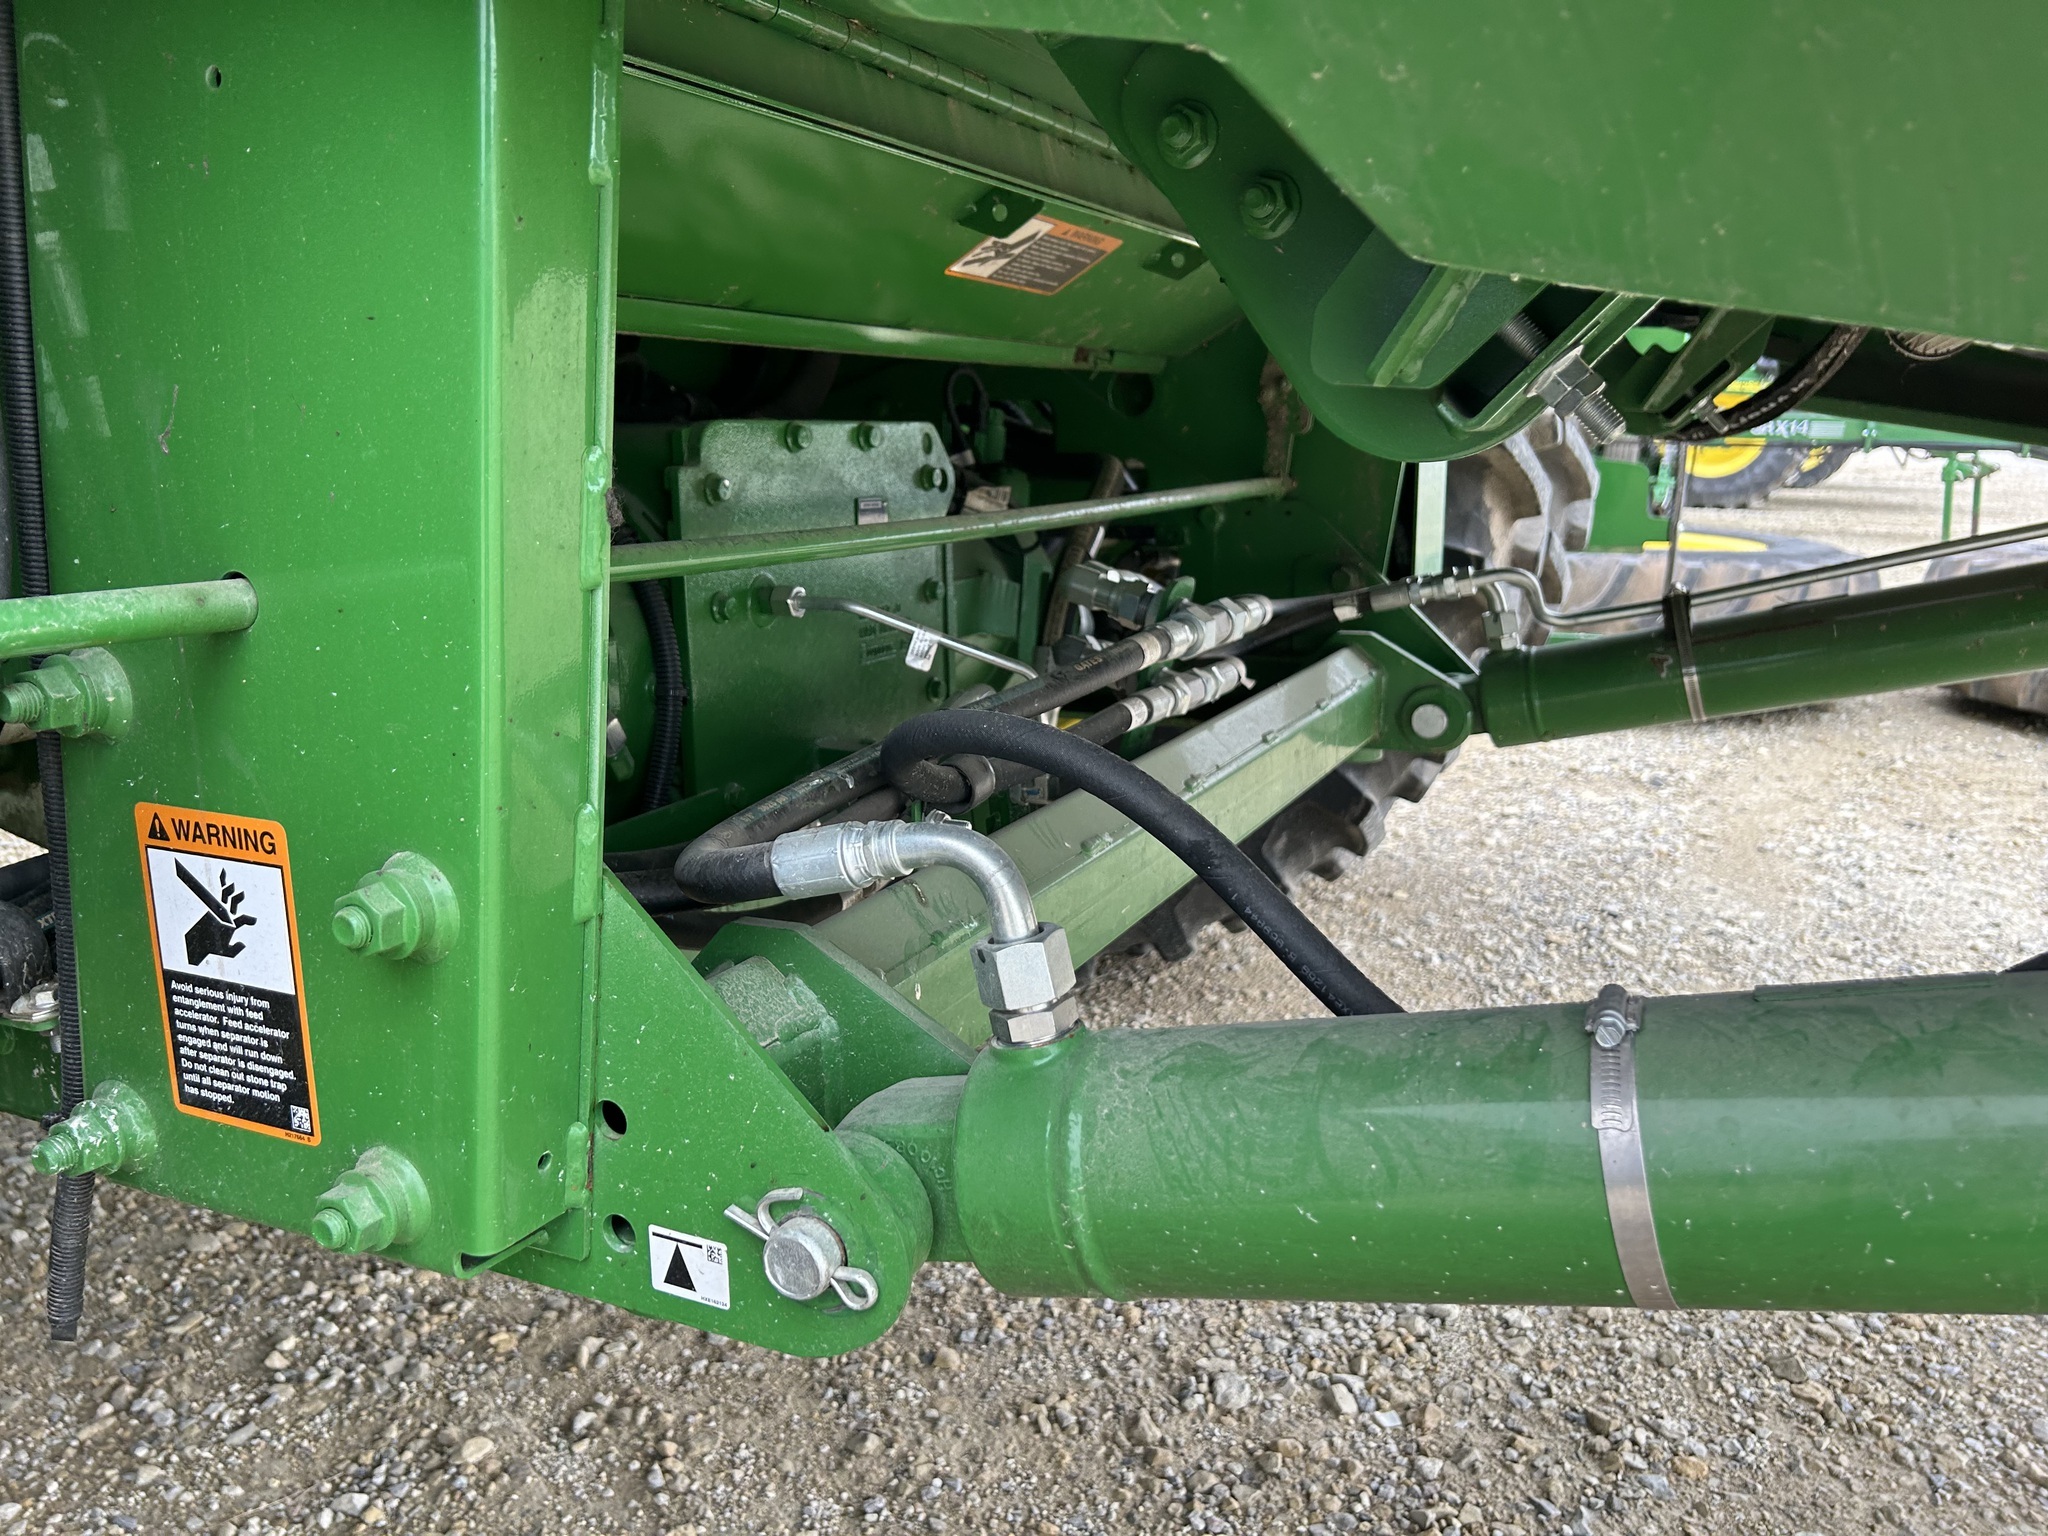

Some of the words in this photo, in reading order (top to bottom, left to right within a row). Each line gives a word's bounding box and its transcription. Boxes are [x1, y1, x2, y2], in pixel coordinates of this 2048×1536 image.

[1074, 655, 1103, 671] GATES
[170, 817, 277, 855] WARNING
[171, 980, 193, 993] Avoid
[194, 986, 224, 1000] serious
[225, 990, 248, 1007] injury
[249, 995, 270, 1009] from
[172, 994, 226, 1013] entanglement
[226, 1005, 245, 1017] with
[245, 1008, 264, 1021] feed
[174, 1007, 220, 1025] accelerator.
[222, 1016, 243, 1030] Feed
[244, 1022, 290, 1039] accelerator
[175, 1019, 197, 1032] turns
[197, 1025, 220, 1037] when
[220, 1030, 259, 1046] separator
[260, 1037, 269, 1048] is
[177, 1034, 211, 1048] engaged
[212, 1041, 228, 1052] and
[229, 1044, 243, 1055] will
[244, 1048, 259, 1059] run
[260, 1050, 283, 1064] down
[179, 1046, 197, 1057] after
[198, 1051, 236, 1066] separator
[237, 1058, 246, 1069] is
[246, 1060, 297, 1080] disengaged.
[181, 1057, 193, 1069] Do
[193, 1062, 207, 1073] not
[208, 1065, 230, 1078] clean
[230, 1071, 245, 1081] out
[245, 1074, 269, 1087] stone
[269, 1079, 288, 1093] trap
[182, 1072, 201, 1083] until
[201, 1076, 211, 1086] all
[212, 1079, 250, 1095] separator
[251, 1088, 281, 1102] motion
[184, 1083, 200, 1095] has
[200, 1089, 235, 1104] stopped.
